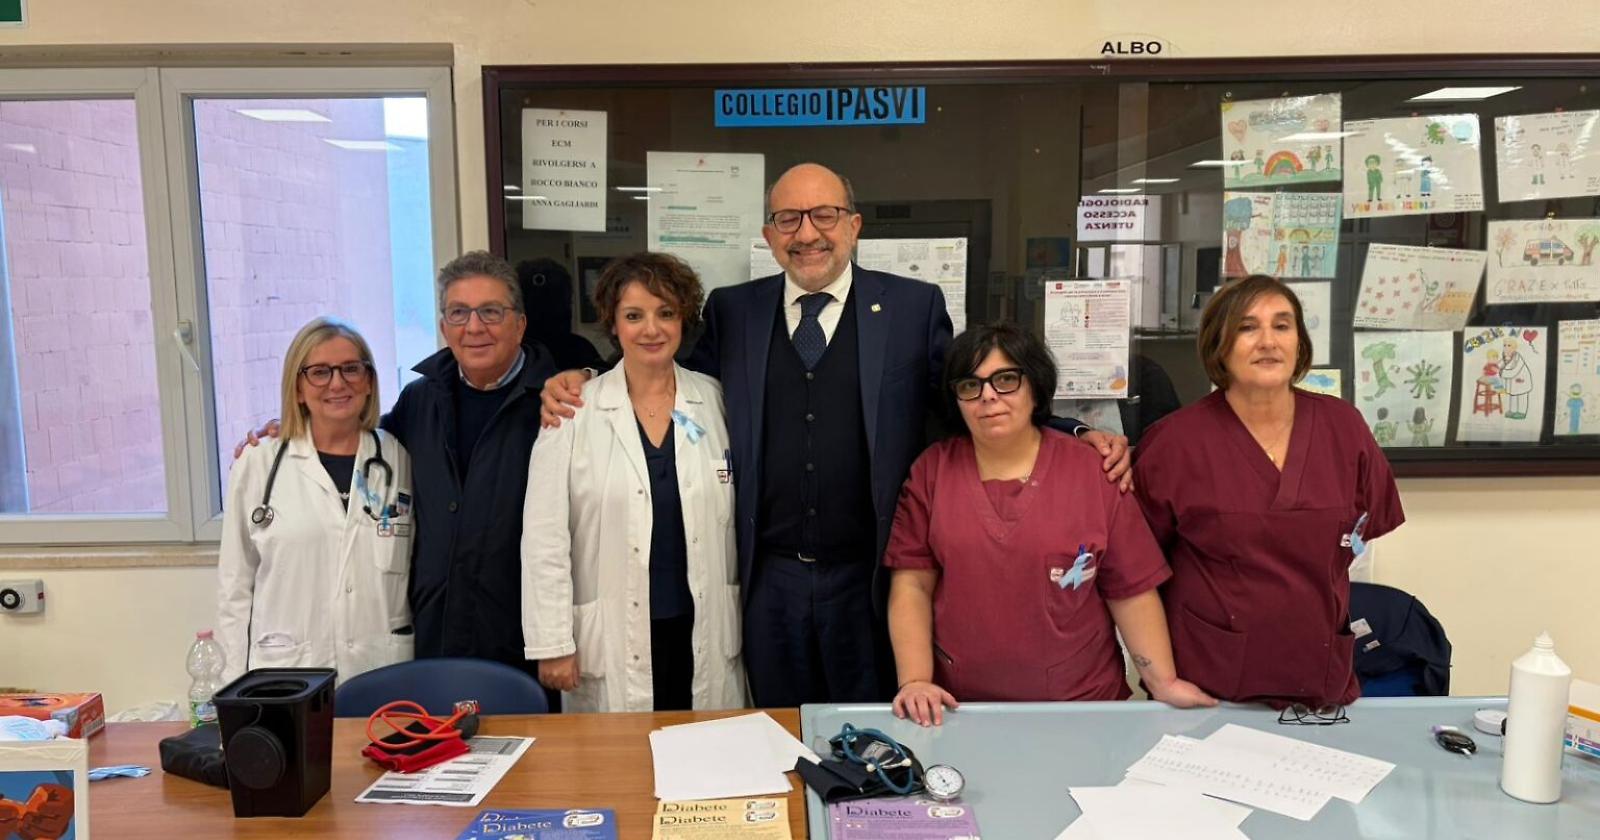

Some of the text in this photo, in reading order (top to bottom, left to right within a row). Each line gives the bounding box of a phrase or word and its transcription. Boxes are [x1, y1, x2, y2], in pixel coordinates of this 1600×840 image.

[1101, 41, 1162, 54] ALBO
[722, 87, 919, 120] COLLEGIO IPASVI
[536, 119, 554, 127] PER
[561, 120, 588, 128] CORSI
[552, 139, 572, 147] ECM
[532, 159, 586, 168] RIVOLGERSI
[530, 179, 598, 188] ROCCO BIANCO
[532, 199, 598, 208] ANNA GAGLIARDI
[662, 803, 727, 812] Diabete
[846, 806, 913, 817] Diabete
[660, 815, 727, 825] Diabete
[483, 820, 551, 833] Diabete
